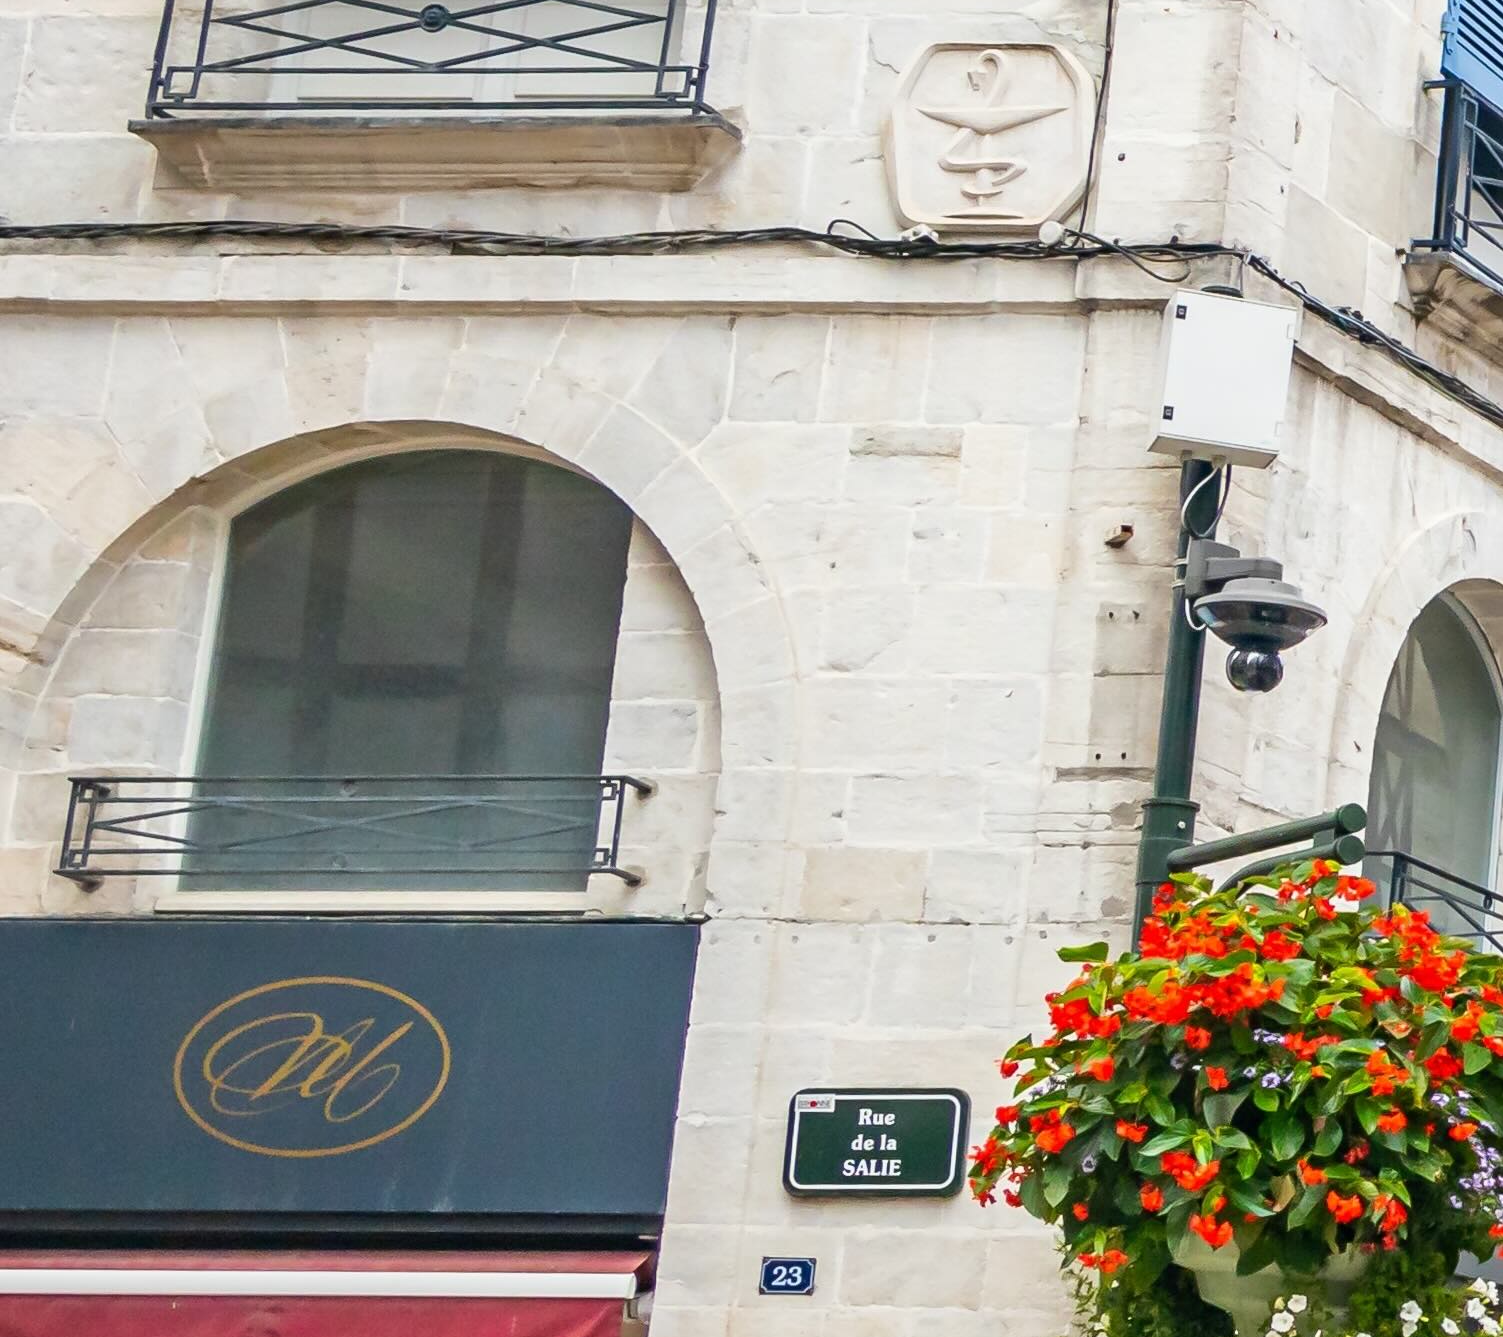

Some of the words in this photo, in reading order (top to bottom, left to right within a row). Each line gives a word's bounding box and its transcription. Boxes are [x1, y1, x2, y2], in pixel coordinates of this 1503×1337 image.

[857, 1108, 896, 1126] Rue
[850, 1133, 875, 1152] de
[879, 1133, 898, 1152] la
[842, 1158, 902, 1177] SALIE
[771, 1265, 803, 1287] 23
